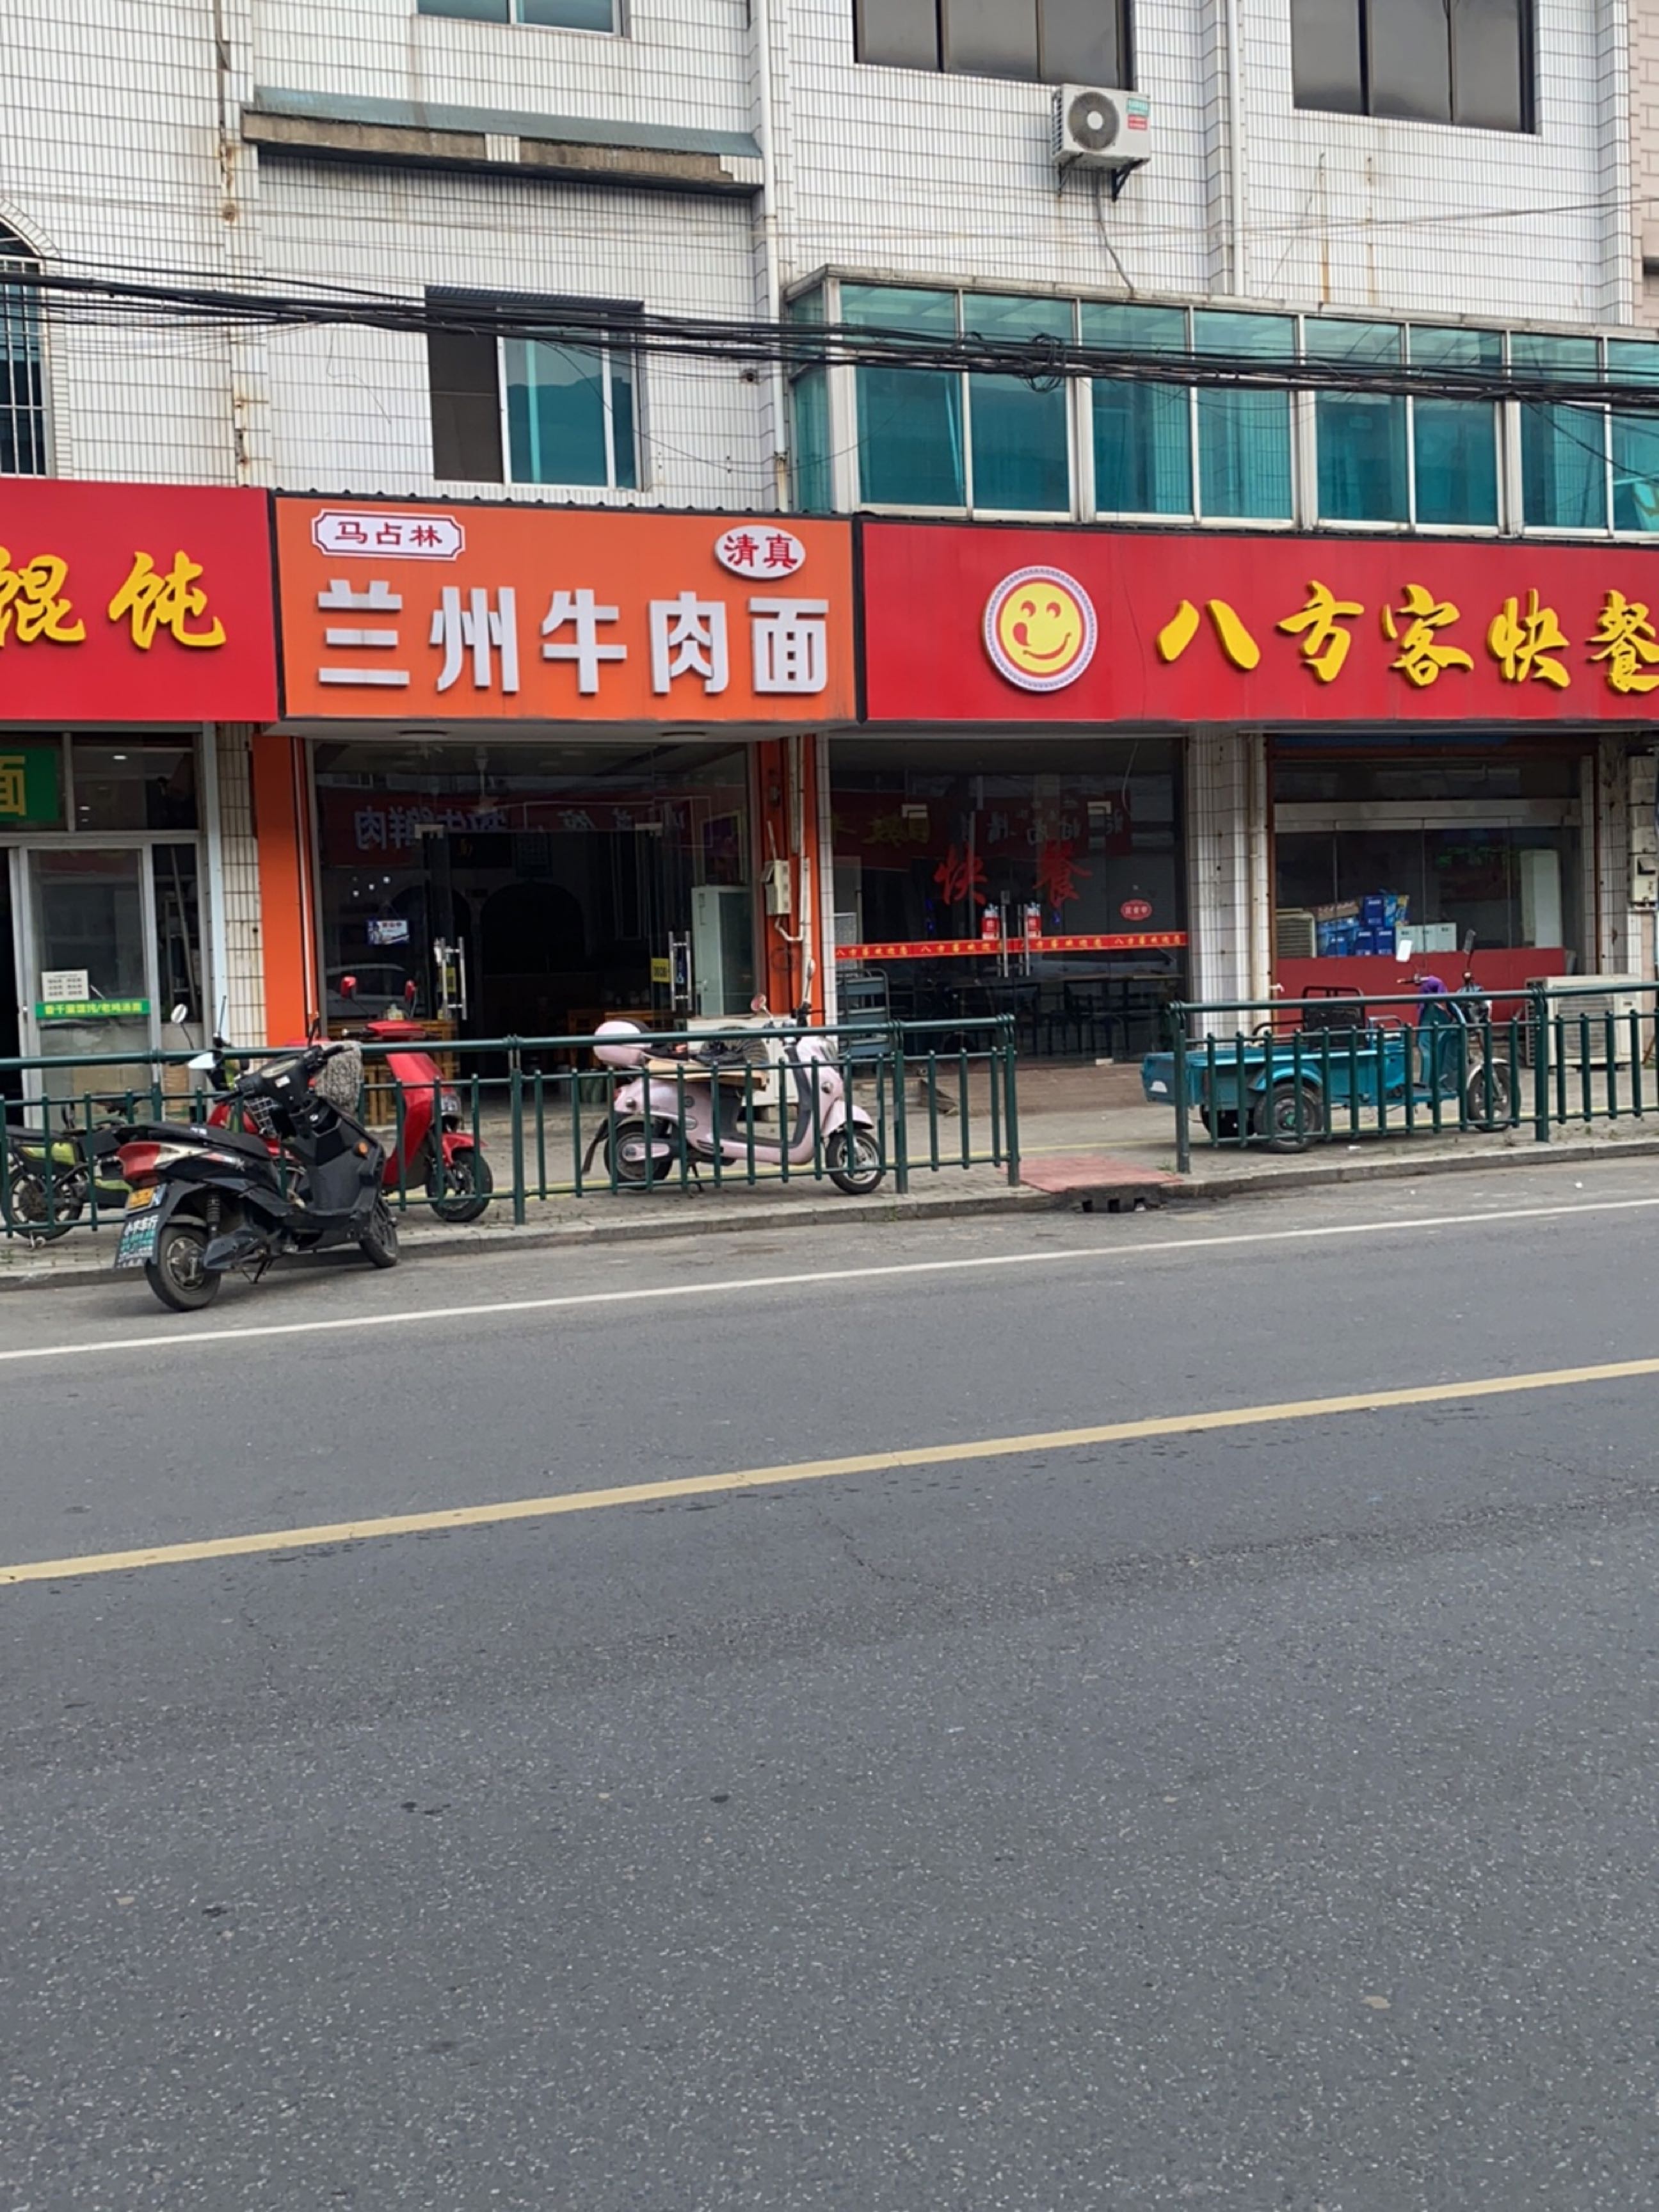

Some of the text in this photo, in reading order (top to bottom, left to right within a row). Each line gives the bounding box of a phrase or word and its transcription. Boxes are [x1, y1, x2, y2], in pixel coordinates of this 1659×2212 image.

[335, 522, 444, 548] 马占林
[724, 534, 798, 569] 清真
[0, 547, 227, 650] 馄饨
[317, 579, 830, 696] 兰州牛肉面
[1156, 580, 1659, 694] 八方客快餐
[933, 840, 1093, 909] 快餐
